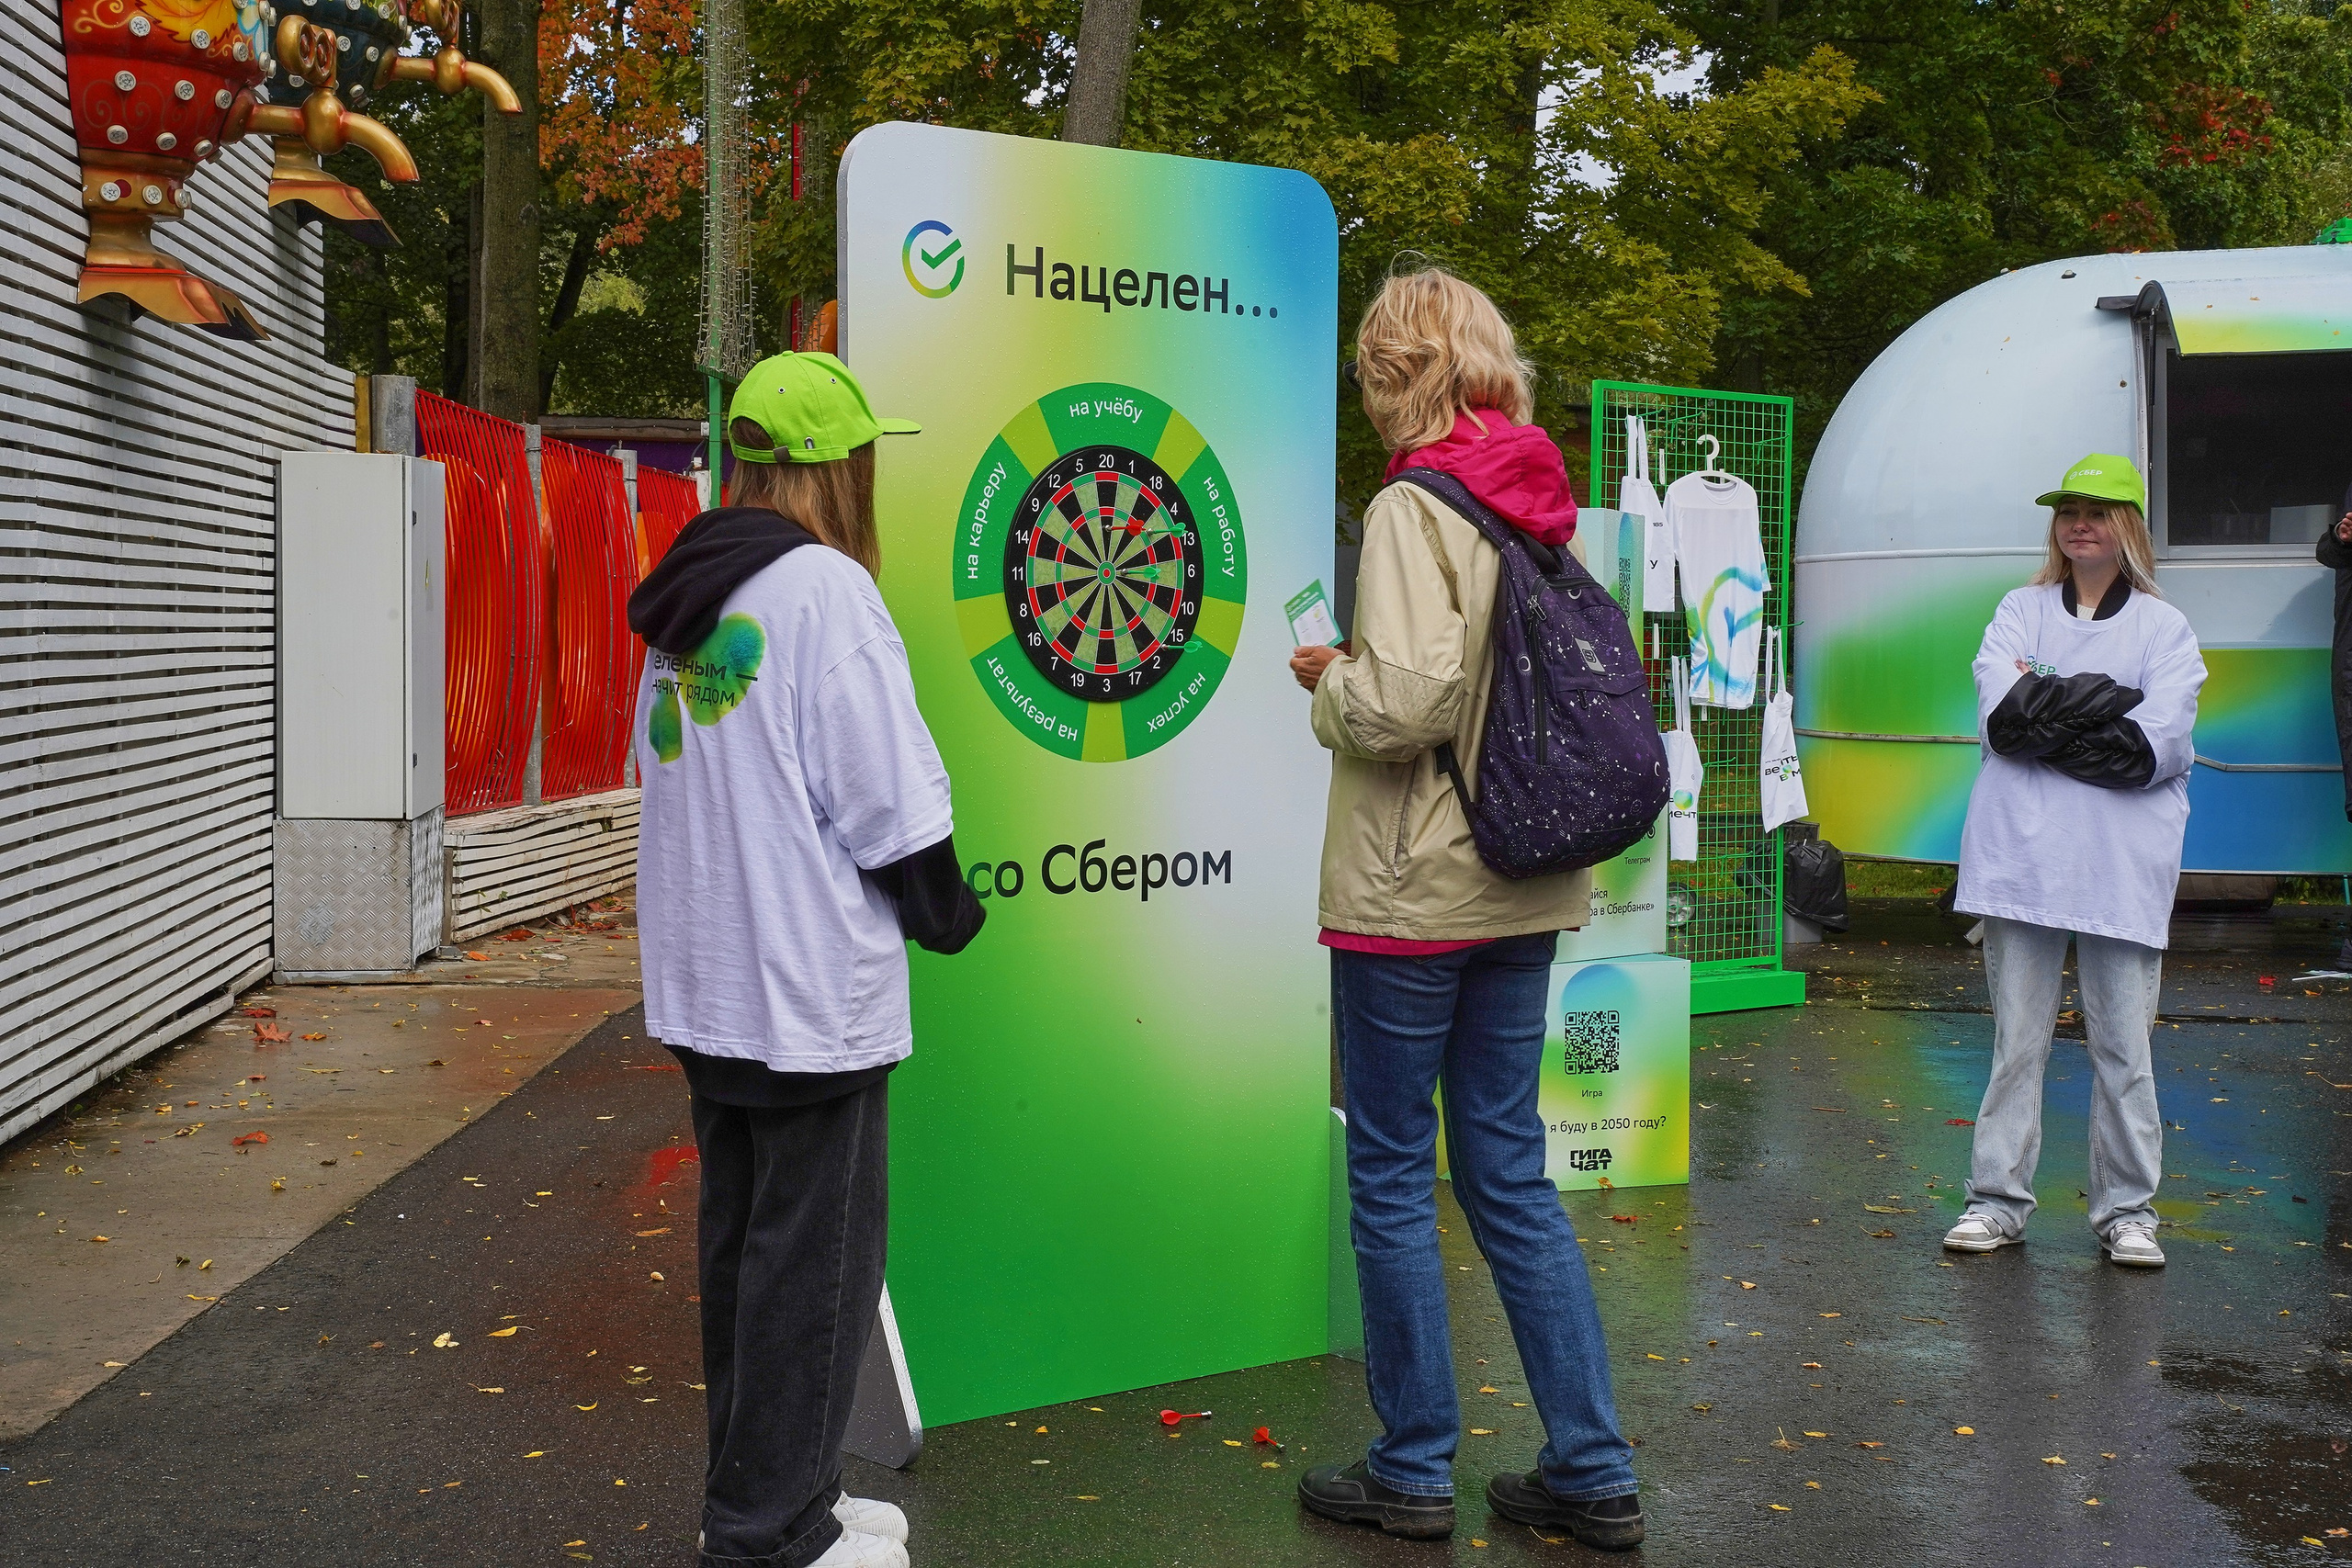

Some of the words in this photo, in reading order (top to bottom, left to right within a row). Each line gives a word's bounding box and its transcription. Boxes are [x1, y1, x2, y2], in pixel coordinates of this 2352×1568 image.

[1006, 243, 1278, 319] Нацелен...
[1069, 400, 1090, 417] на
[1094, 398, 1143, 423] учёбу
[1076, 459, 1083, 472] 5
[1098, 454, 1114, 468] 20
[1129, 461, 1135, 473] 1
[1048, 474, 1061, 488] 12
[1149, 476, 1163, 491] 18
[970, 461, 1008, 547] карьеру
[1032, 498, 1040, 512] 9
[1170, 502, 1178, 515] 4
[1203, 476, 1220, 502] на
[1212, 504, 1236, 578] работу
[1015, 530, 1030, 545] 14
[1182, 533, 1195, 546] 13
[967, 556, 978, 579] на
[1012, 567, 1024, 581] 11
[1188, 564, 1195, 578] 6
[1020, 604, 1028, 617] 8
[1182, 602, 1194, 615] 10
[1027, 632, 1042, 647] 16
[1170, 628, 1183, 643] 15
[654, 654, 727, 680] еленым
[1050, 657, 1058, 671] 7
[1153, 655, 1160, 670] 2
[1070, 673, 1085, 687] 19
[1102, 678, 1111, 692] 3
[1128, 671, 1142, 685] 17
[1188, 672, 1206, 696] на
[651, 678, 683, 696] начит
[686, 683, 735, 706] рядом
[986, 656, 1057, 732] результат
[1147, 691, 1190, 733] успех
[1058, 724, 1079, 741] на
[1624, 856, 1651, 865] Телеграм
[967, 860, 1023, 899] со
[1042, 838, 1231, 902] Сбером
[1590, 887, 1608, 899] айся
[1600, 907, 1605, 916] в
[1607, 901, 1655, 916] Сбербанке»
[1581, 1089, 1603, 1100] Игра
[1550, 1124, 1556, 1133] я
[1560, 1120, 1588, 1134] буду
[1591, 1122, 1598, 1131] в
[1600, 1117, 1631, 1130] 2050
[1634, 1115, 1667, 1130] году?
[1570, 1148, 1612, 1161] ГИГА
